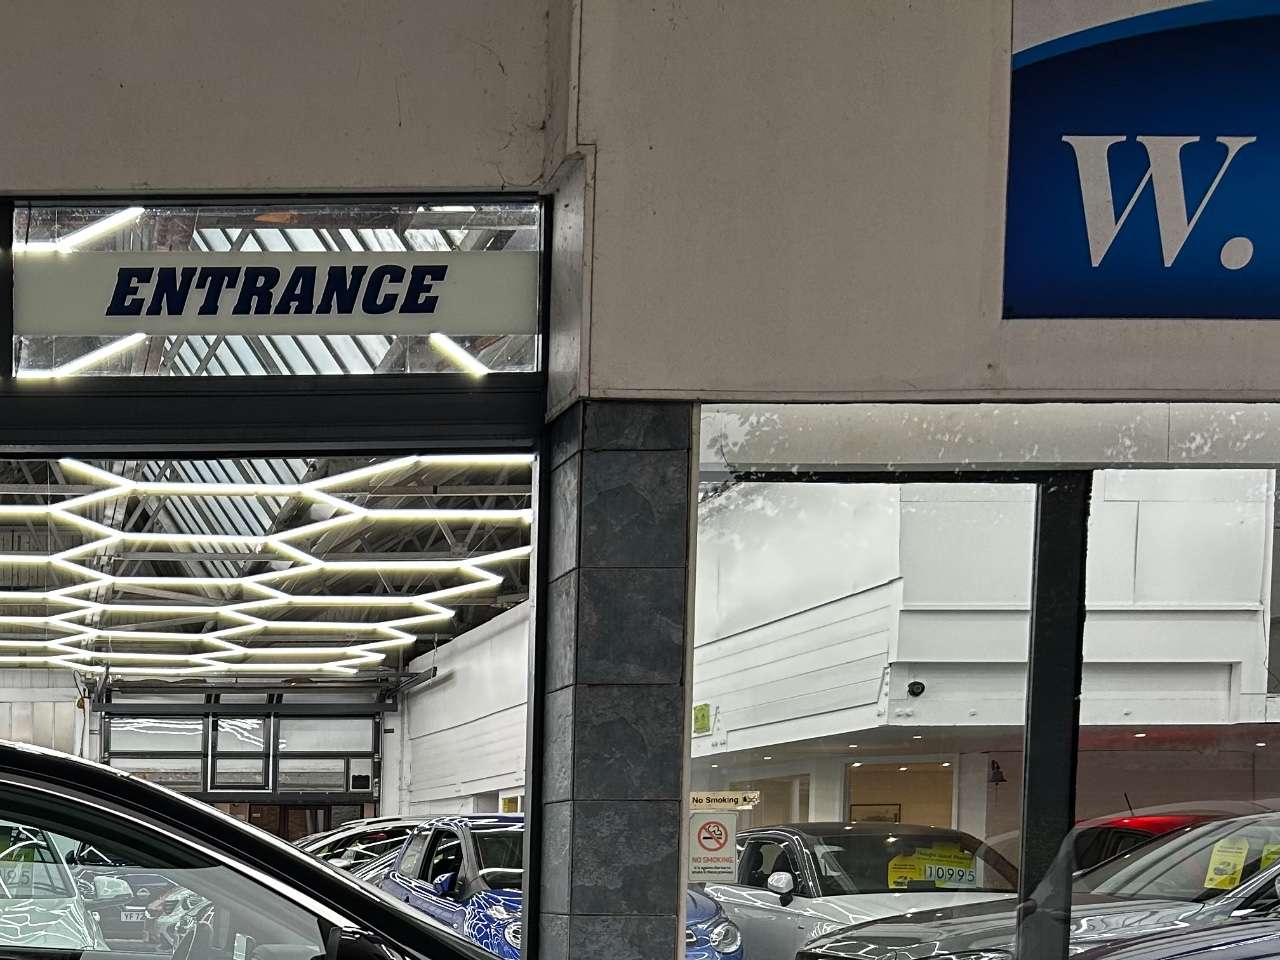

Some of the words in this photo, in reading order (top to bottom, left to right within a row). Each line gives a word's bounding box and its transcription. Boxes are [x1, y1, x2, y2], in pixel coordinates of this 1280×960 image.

[1061, 135, 1258, 270] W.
[104, 264, 449, 317] ENTRANCE
[692, 796, 704, 804] No
[705, 796, 739, 805] Smoking
[927, 866, 976, 882] 10995
